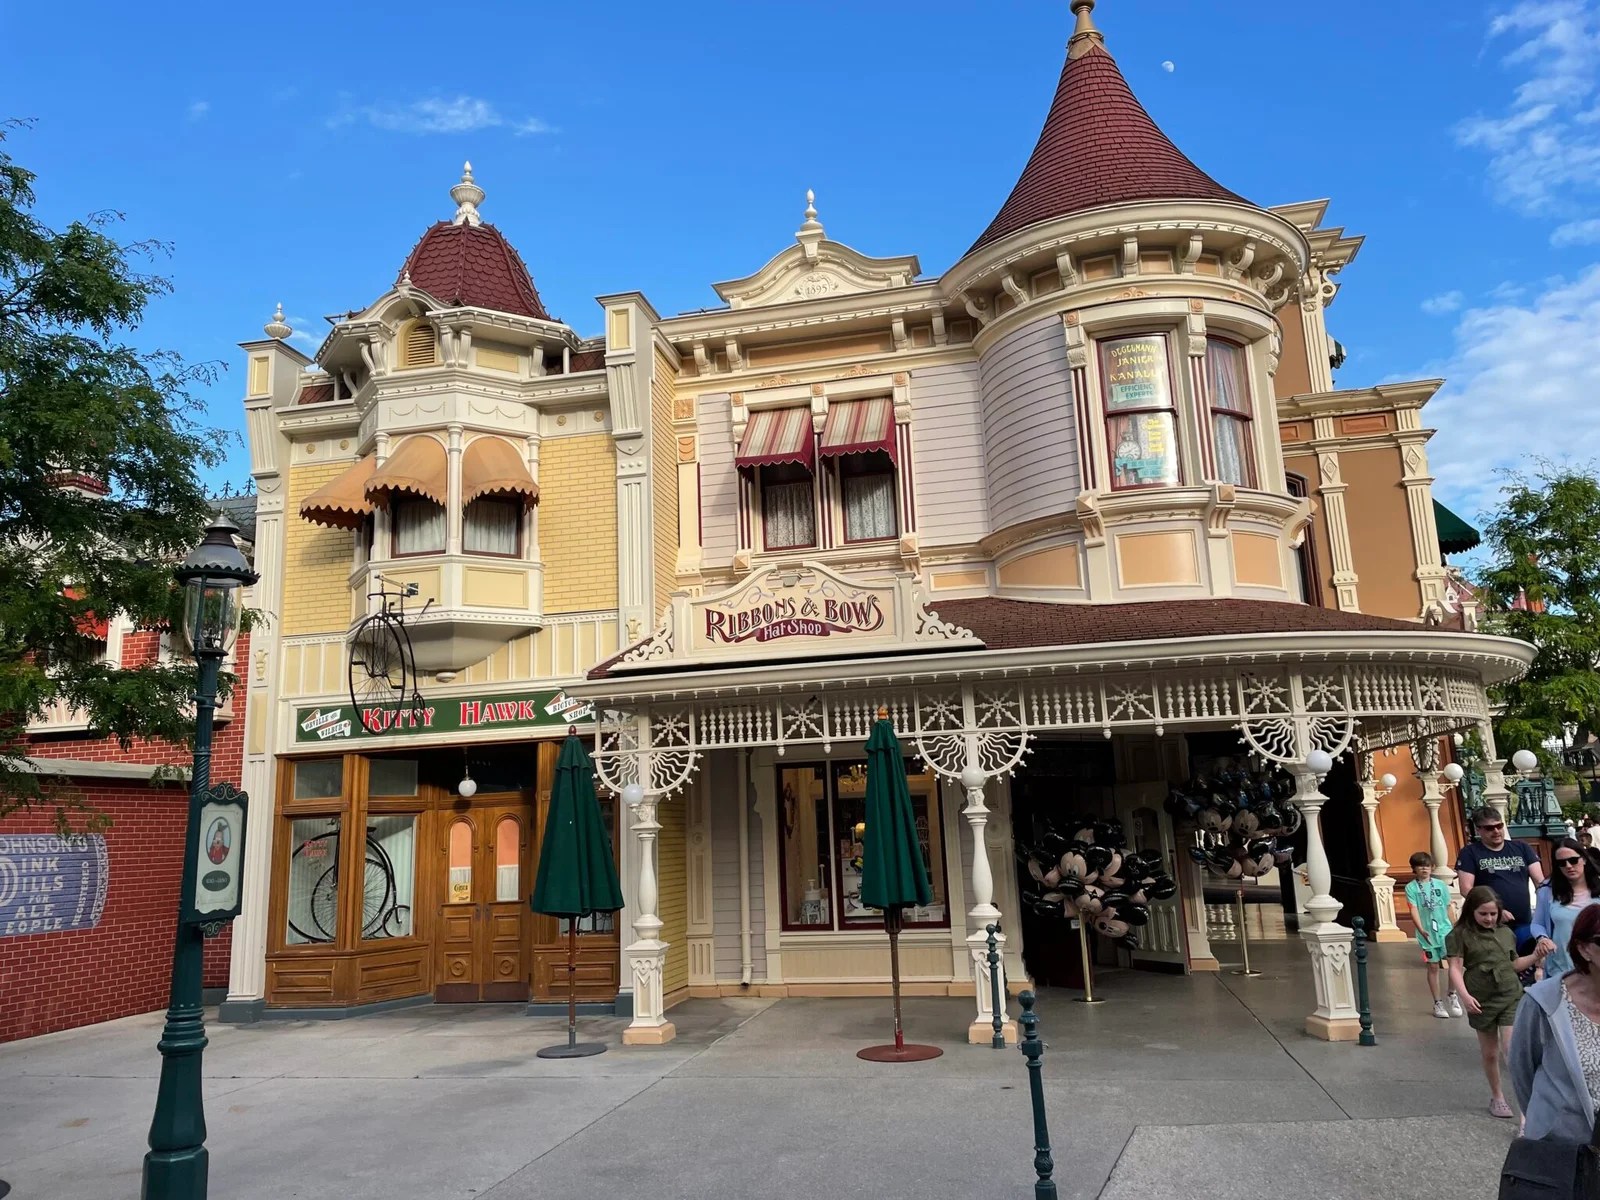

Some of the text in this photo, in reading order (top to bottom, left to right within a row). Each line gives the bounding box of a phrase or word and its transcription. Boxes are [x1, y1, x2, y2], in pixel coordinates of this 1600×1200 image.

[807, 283, 828, 295] 1895
[705, 594, 884, 643] RIBBONS & BOWS
[763, 622, 822, 641] Hat Shop
[361, 701, 535, 732] KITTY HAWK
